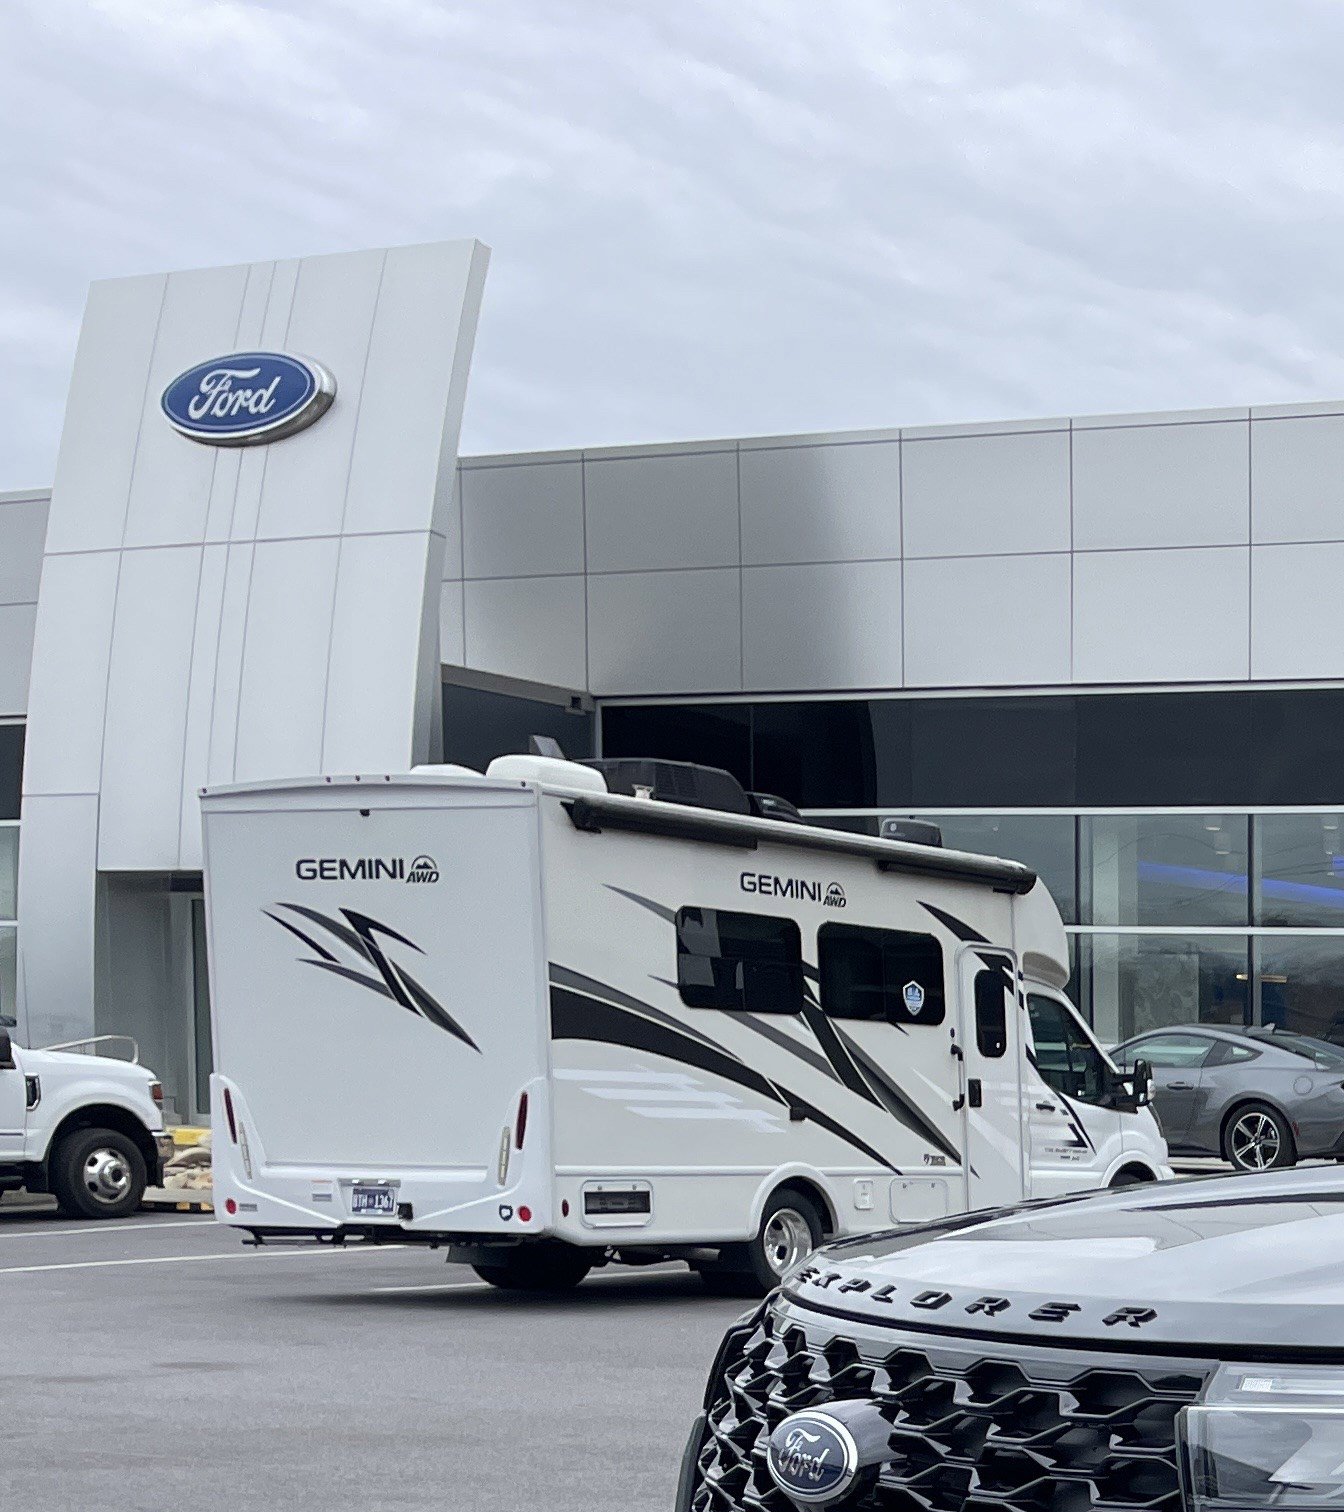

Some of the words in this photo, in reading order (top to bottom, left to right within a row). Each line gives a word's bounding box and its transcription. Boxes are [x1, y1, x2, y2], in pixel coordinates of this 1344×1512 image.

[188, 367, 281, 420] Ford
[295, 858, 404, 881] GEMINI
[406, 870, 440, 884] AWD
[740, 871, 822, 903] GEMINI
[823, 895, 847, 908] AWD
[799, 1267, 1158, 1328] EXPLORER
[778, 1428, 830, 1482] Ford
